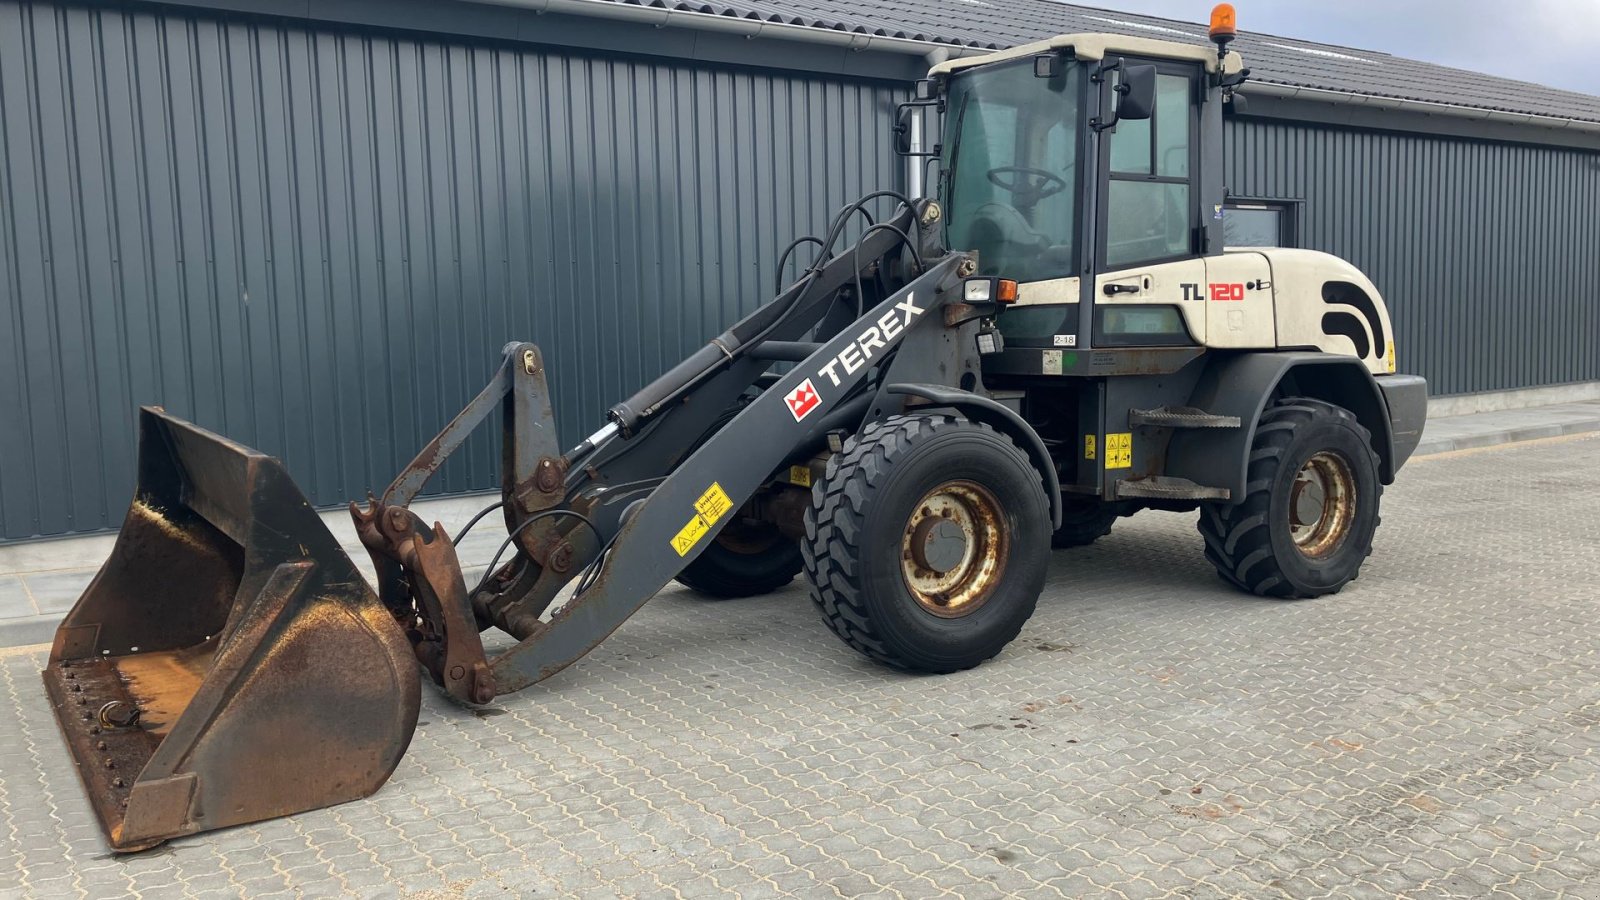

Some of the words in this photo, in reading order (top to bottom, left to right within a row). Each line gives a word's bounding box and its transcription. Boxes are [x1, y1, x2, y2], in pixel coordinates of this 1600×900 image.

[1180, 283, 1204, 301] TL
[1208, 283, 1245, 301] 120
[817, 290, 926, 387] TEREX
[1054, 336, 1074, 344] 2-18
